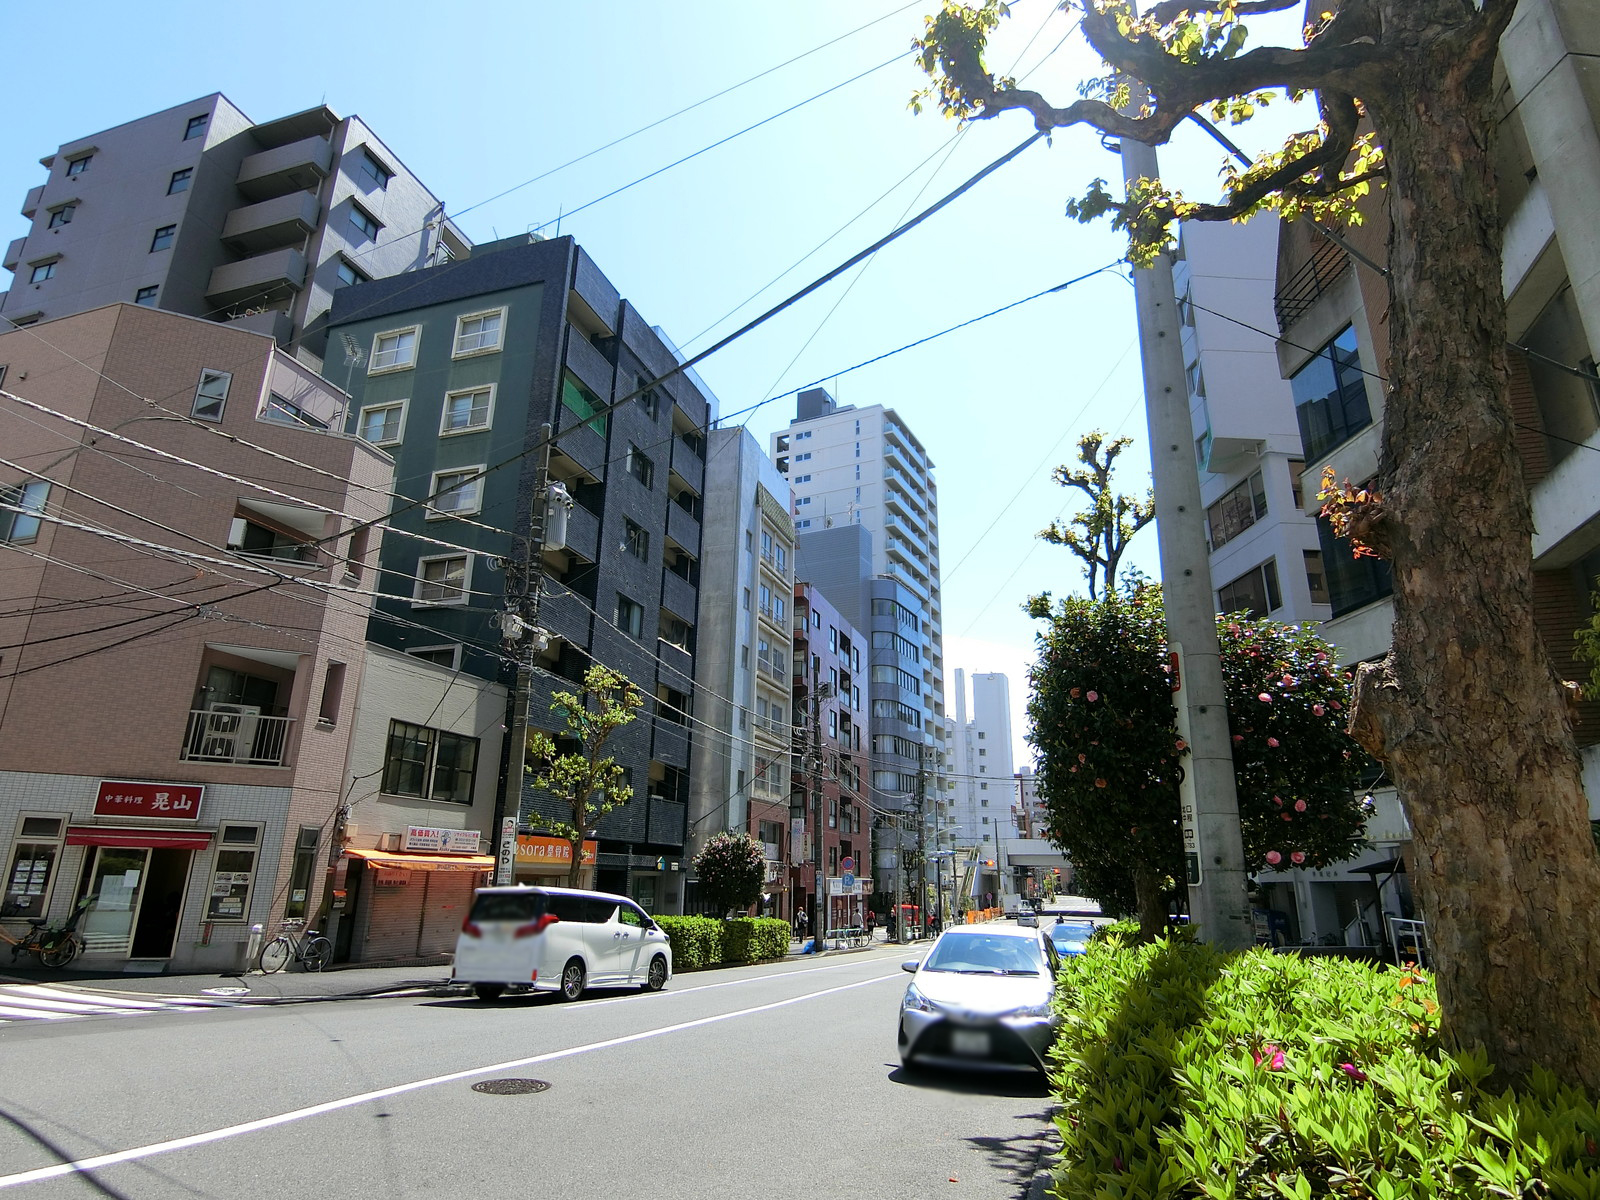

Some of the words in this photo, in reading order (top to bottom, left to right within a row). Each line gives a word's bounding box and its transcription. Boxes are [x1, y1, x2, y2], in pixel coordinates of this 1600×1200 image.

[105, 794, 143, 804] 中華料理
[150, 792, 193, 811] 晃山
[547, 844, 570, 858] 整骨院
